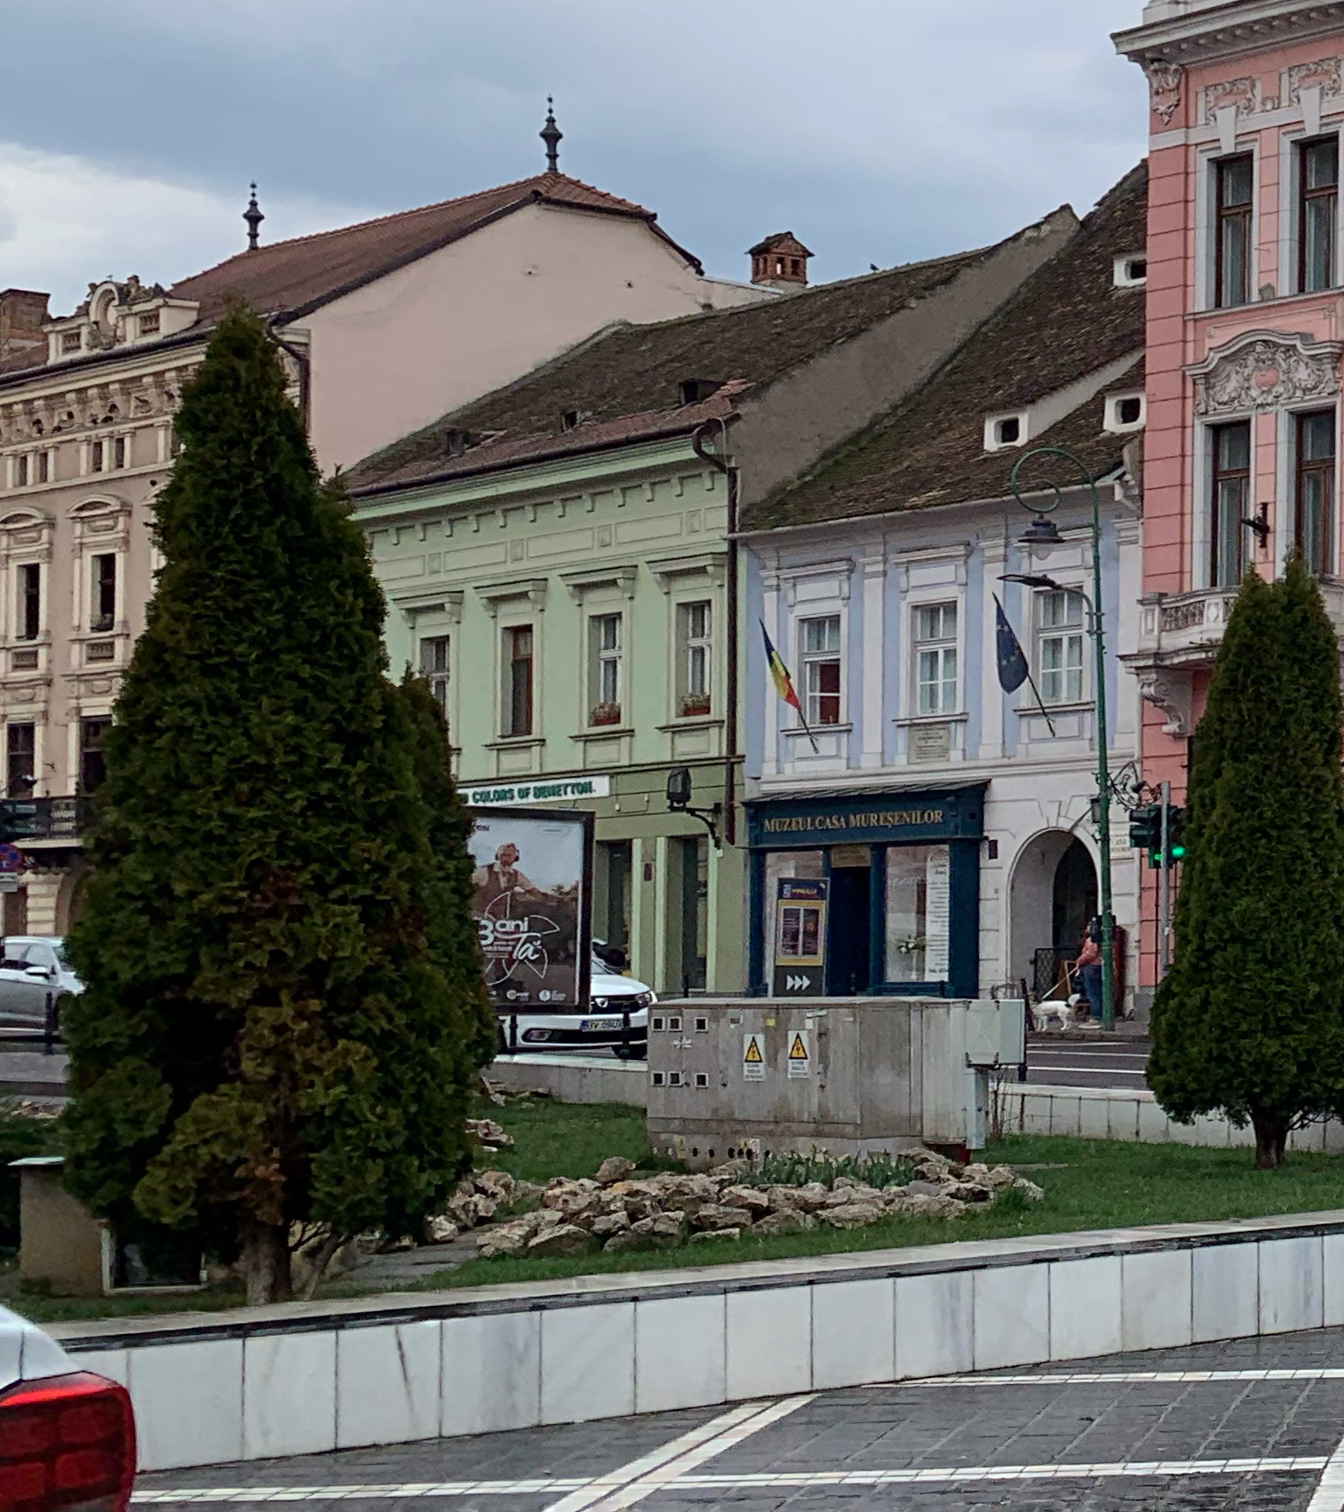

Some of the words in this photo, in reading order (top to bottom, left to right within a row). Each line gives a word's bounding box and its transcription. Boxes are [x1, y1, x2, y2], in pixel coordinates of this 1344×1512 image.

[472, 788, 515, 803] COLORS
[517, 787, 531, 799] OF
[764, 817, 815, 832] MUZEUL
[815, 815, 846, 830] CASA
[495, 917, 529, 932] ani
